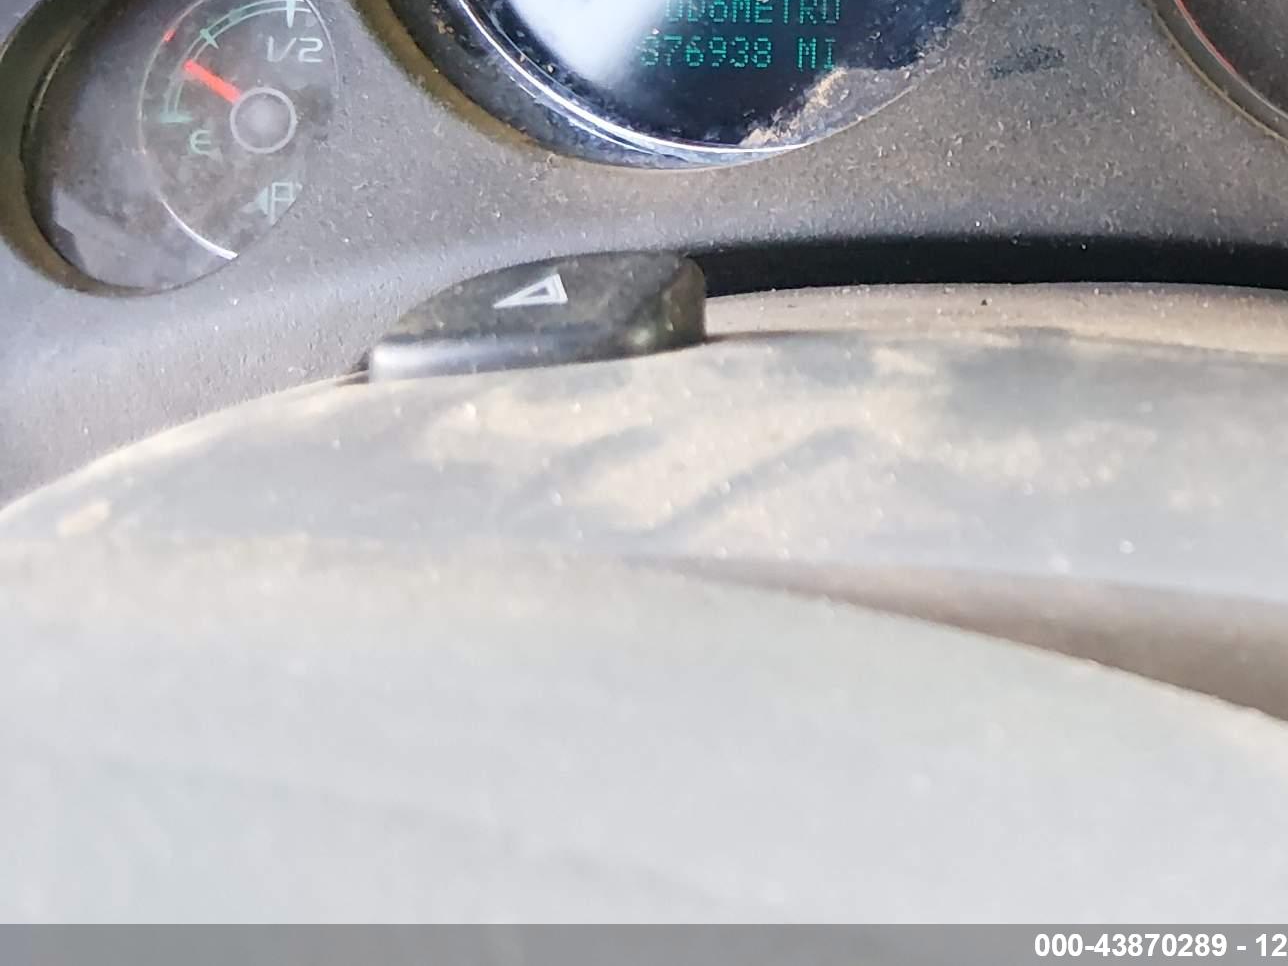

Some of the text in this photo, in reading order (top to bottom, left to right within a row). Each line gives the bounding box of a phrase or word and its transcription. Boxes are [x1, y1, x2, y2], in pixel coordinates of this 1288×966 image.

[267, 36, 324, 63] 1/2
[798, 37, 838, 71] MI
[189, 129, 214, 157] E
